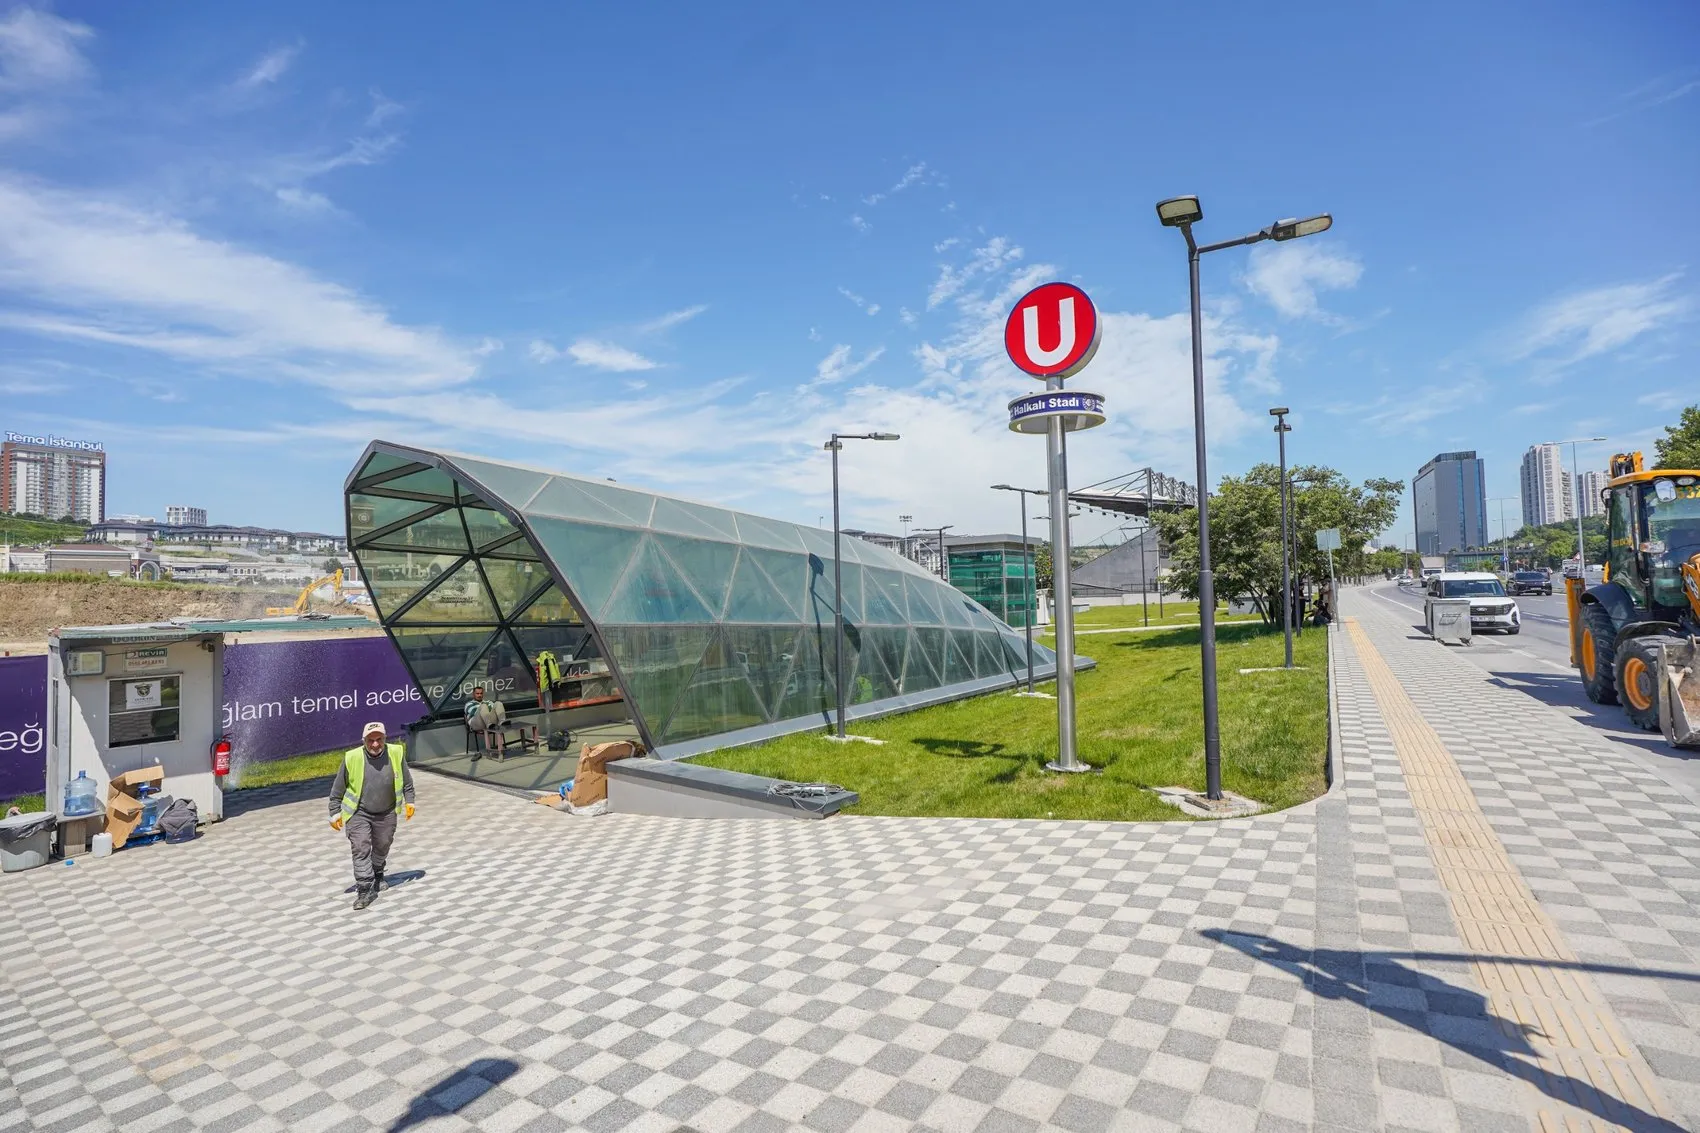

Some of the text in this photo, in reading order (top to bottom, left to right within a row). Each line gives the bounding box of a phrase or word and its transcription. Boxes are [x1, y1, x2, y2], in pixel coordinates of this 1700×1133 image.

[1023, 297, 1076, 367] U
[1014, 401, 1045, 416] Halkalı
[1049, 398, 1079, 408] Stadı
[6, 431, 103, 450] Tema İstanbul
[291, 689, 357, 715] temel
